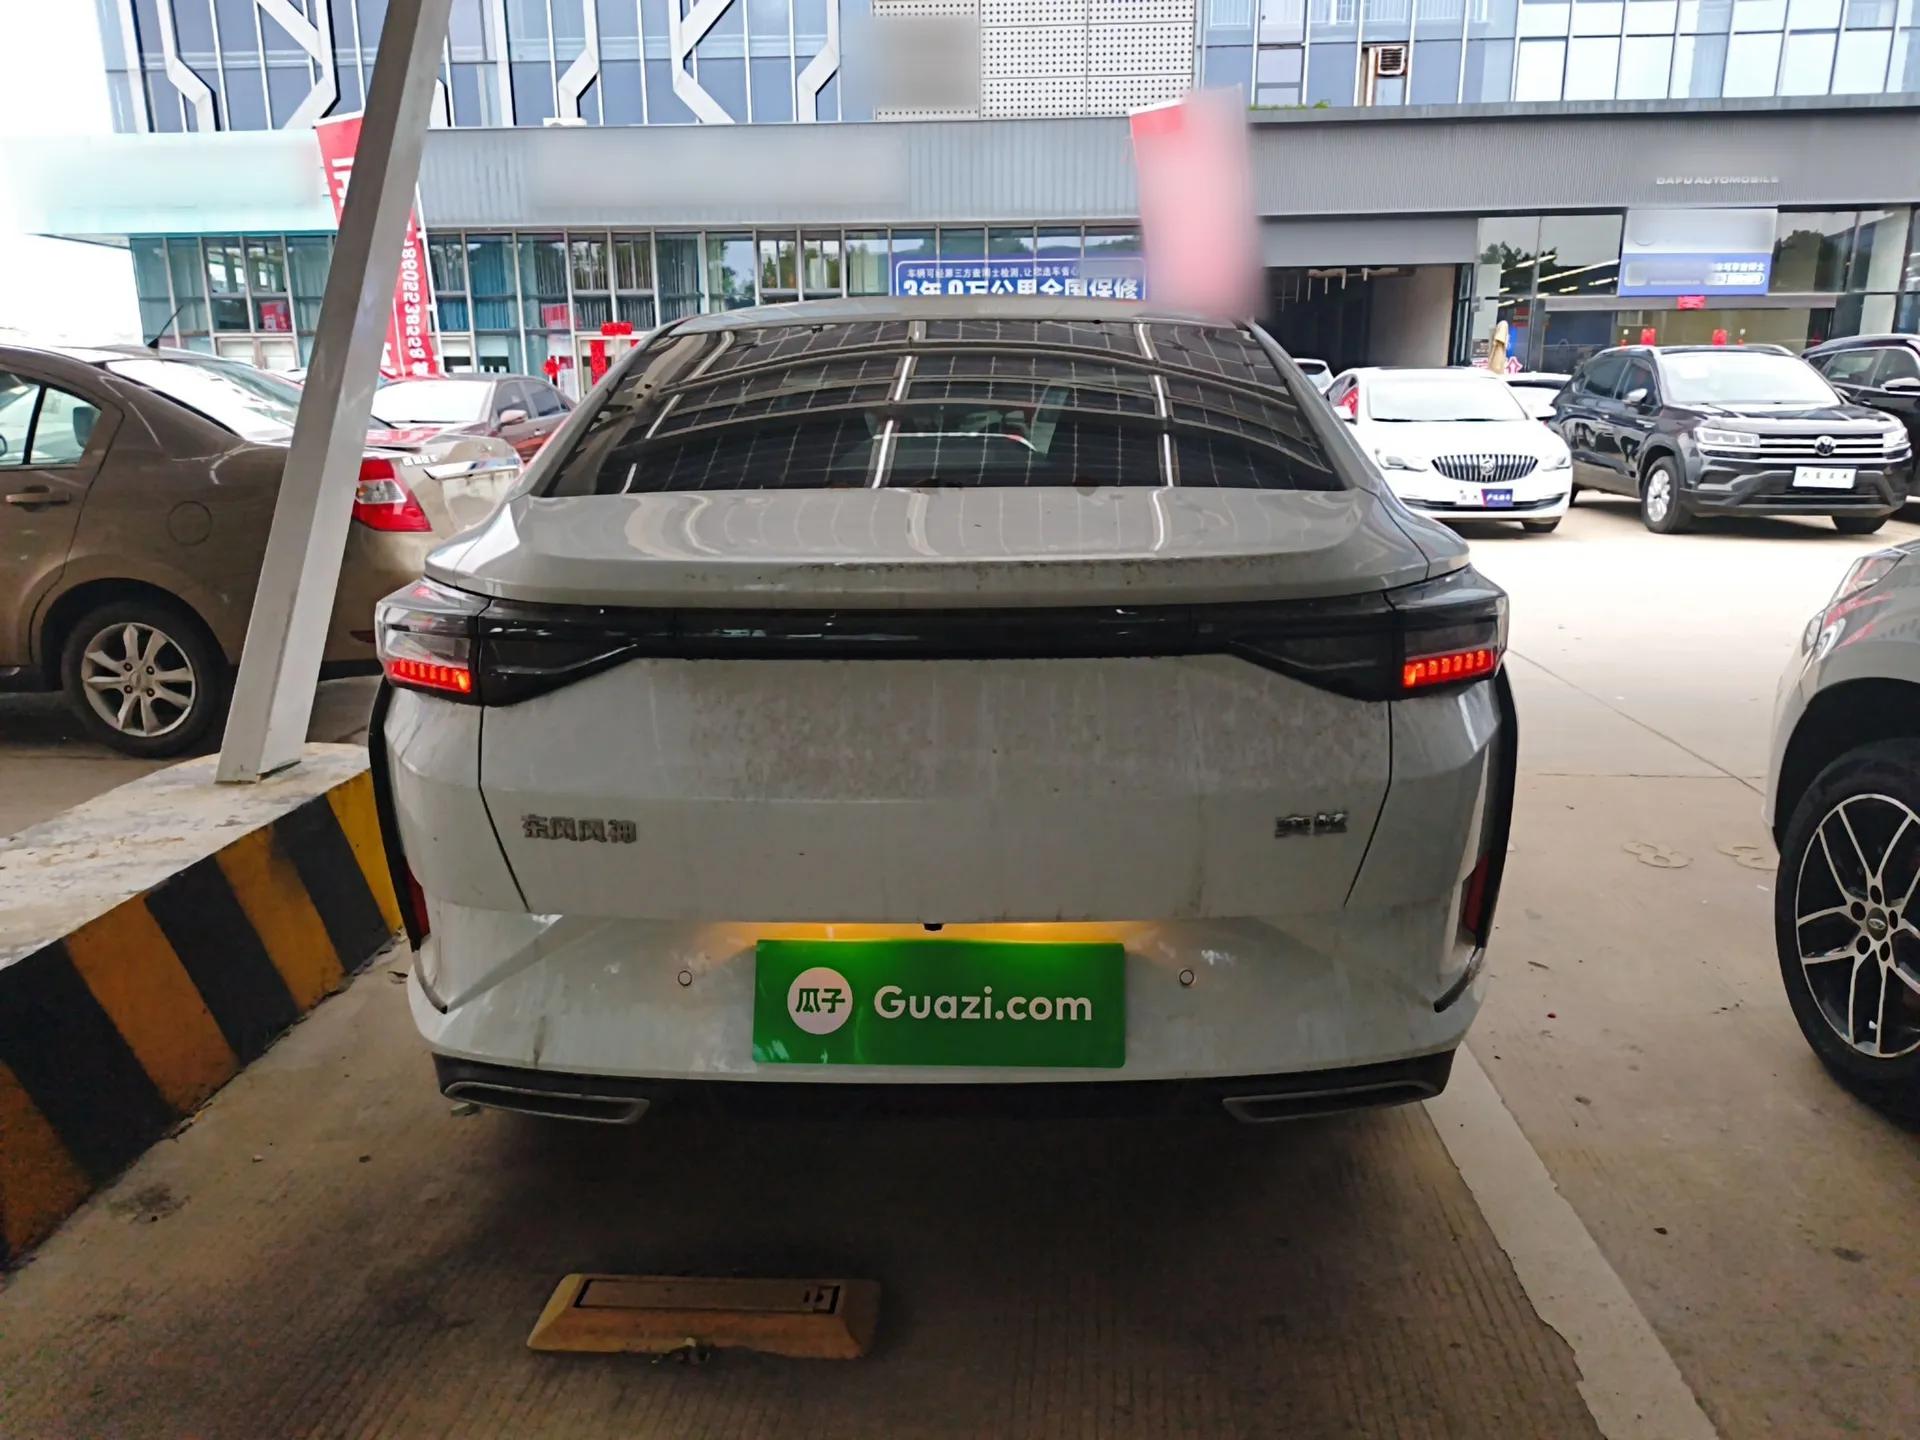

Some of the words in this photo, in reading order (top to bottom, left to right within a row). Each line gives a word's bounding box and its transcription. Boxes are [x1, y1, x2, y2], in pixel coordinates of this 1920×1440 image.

[521, 814, 637, 844] 东风风神
[795, 987, 846, 1015] 瓜子
[874, 985, 1093, 1021] Guazi.com
